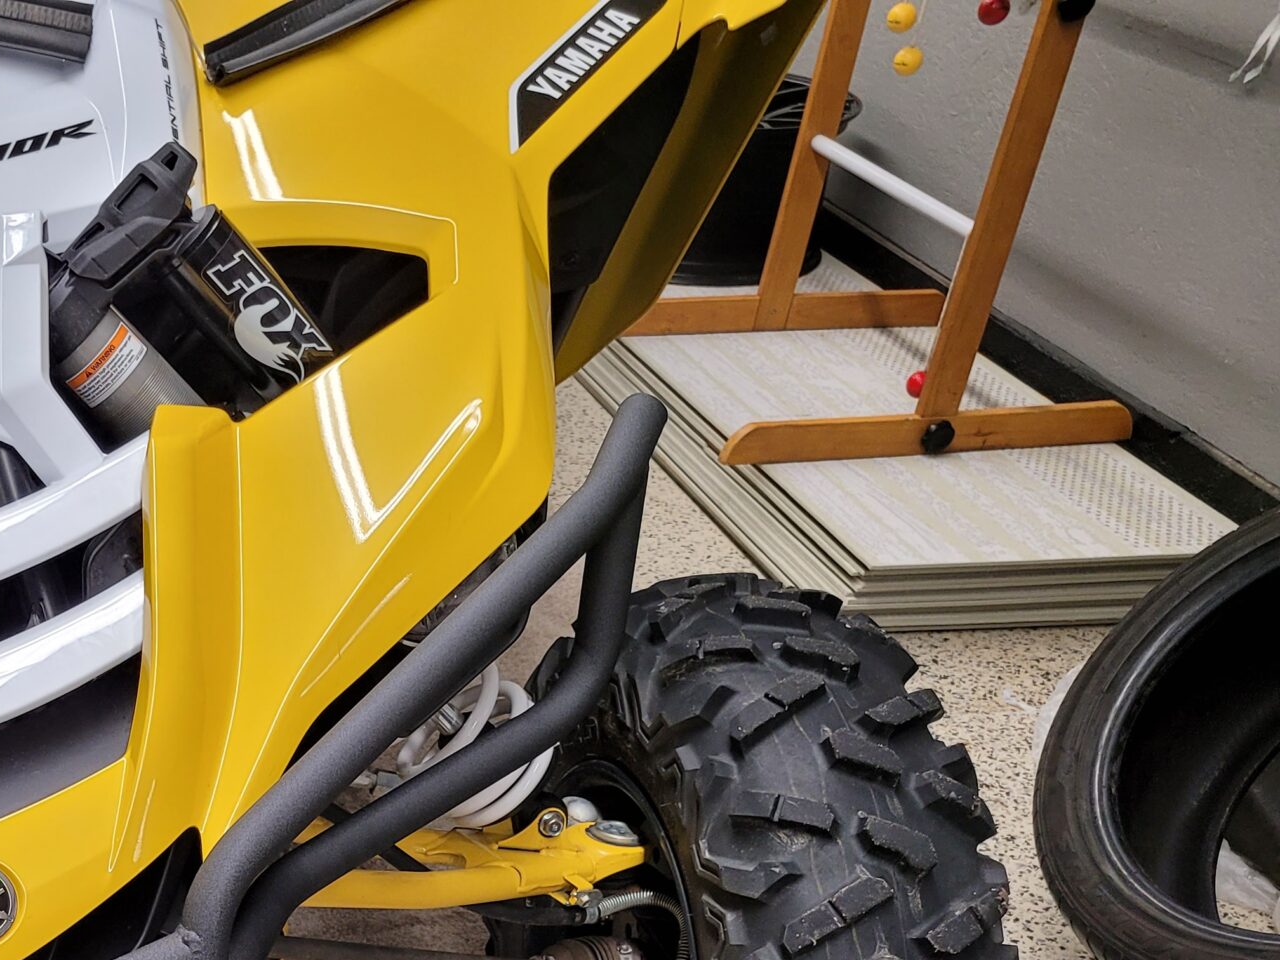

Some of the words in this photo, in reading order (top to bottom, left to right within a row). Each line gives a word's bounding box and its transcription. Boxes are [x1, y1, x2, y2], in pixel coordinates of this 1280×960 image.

[155, 18, 169, 70] SHIFT
[526, 9, 641, 99] YAMAHA
[164, 75, 179, 144] ENTIAL
[206, 249, 333, 370] FOX
[91, 344, 116, 371] WARNING
